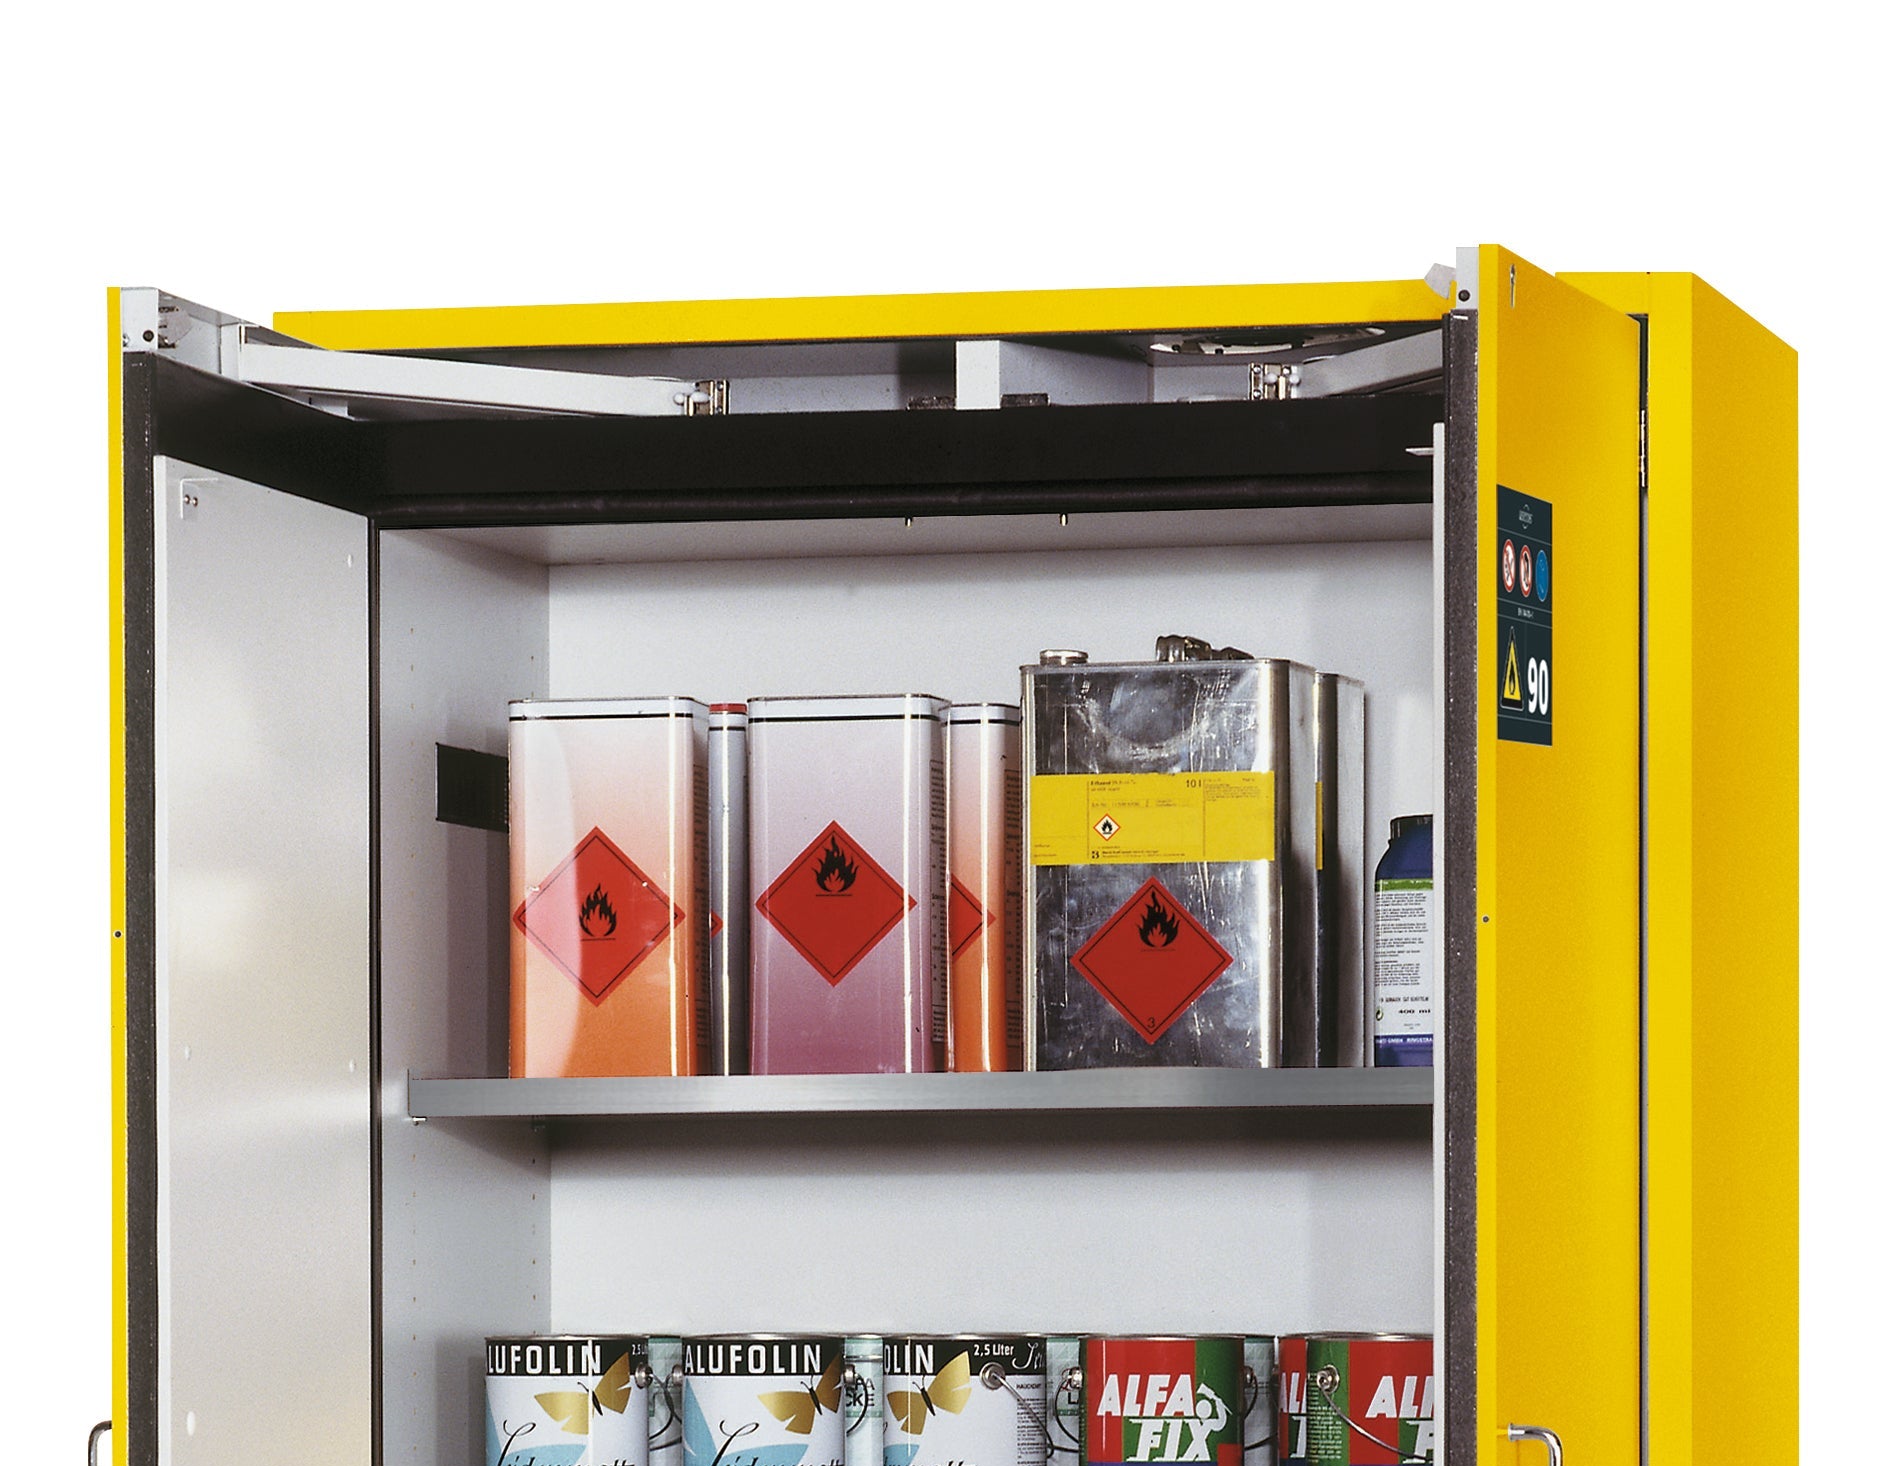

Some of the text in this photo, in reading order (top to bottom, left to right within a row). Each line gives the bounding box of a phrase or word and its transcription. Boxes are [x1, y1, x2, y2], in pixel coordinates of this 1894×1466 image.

[1527, 656, 1549, 716] 90
[1147, 1016, 1156, 1029] 3
[685, 1344, 821, 1374] ALUFOLIN
[974, 1343, 991, 1357] 2,5
[992, 1343, 1014, 1356] Liter
[1097, 1374, 1195, 1417] ALFA
[1126, 1418, 1215, 1462] FIX
